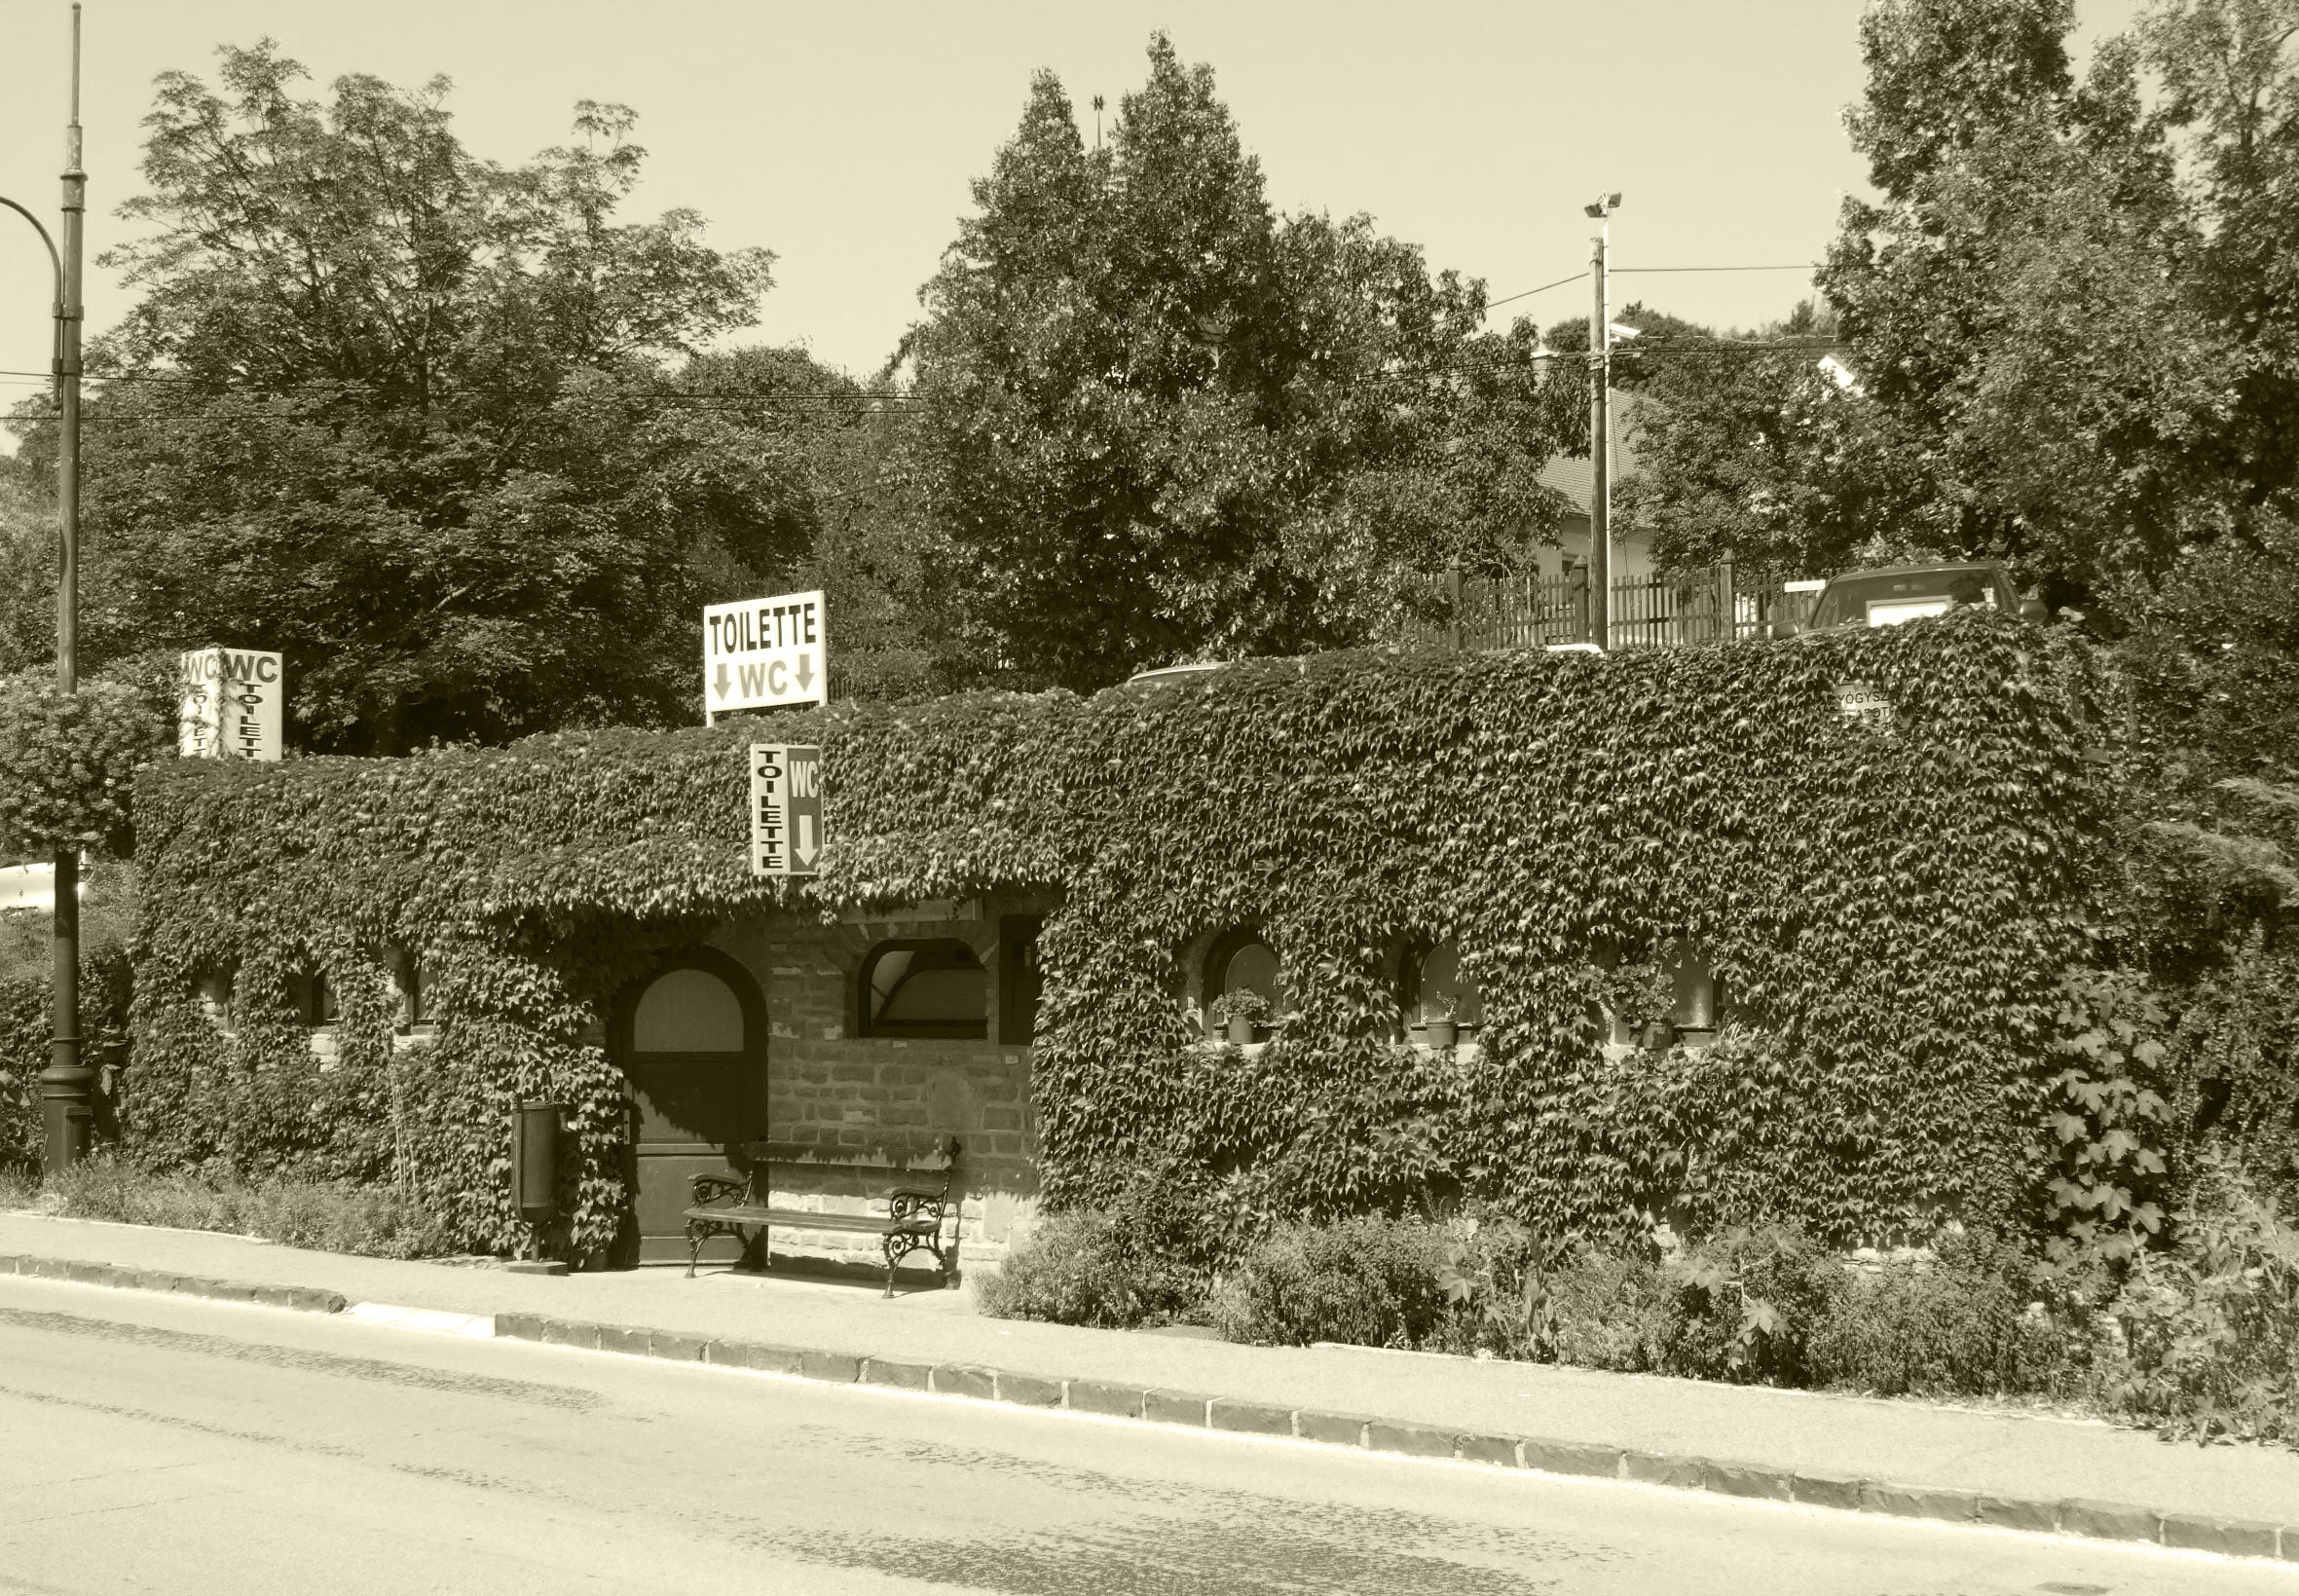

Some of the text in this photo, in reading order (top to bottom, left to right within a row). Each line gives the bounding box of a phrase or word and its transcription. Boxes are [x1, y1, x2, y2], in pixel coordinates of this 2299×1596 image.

[709, 602, 817, 655] TOILETTE
[224, 652, 278, 684] WC
[738, 659, 788, 699] WC
[790, 761, 820, 798] WC
[757, 750, 784, 869] TOILETTE
